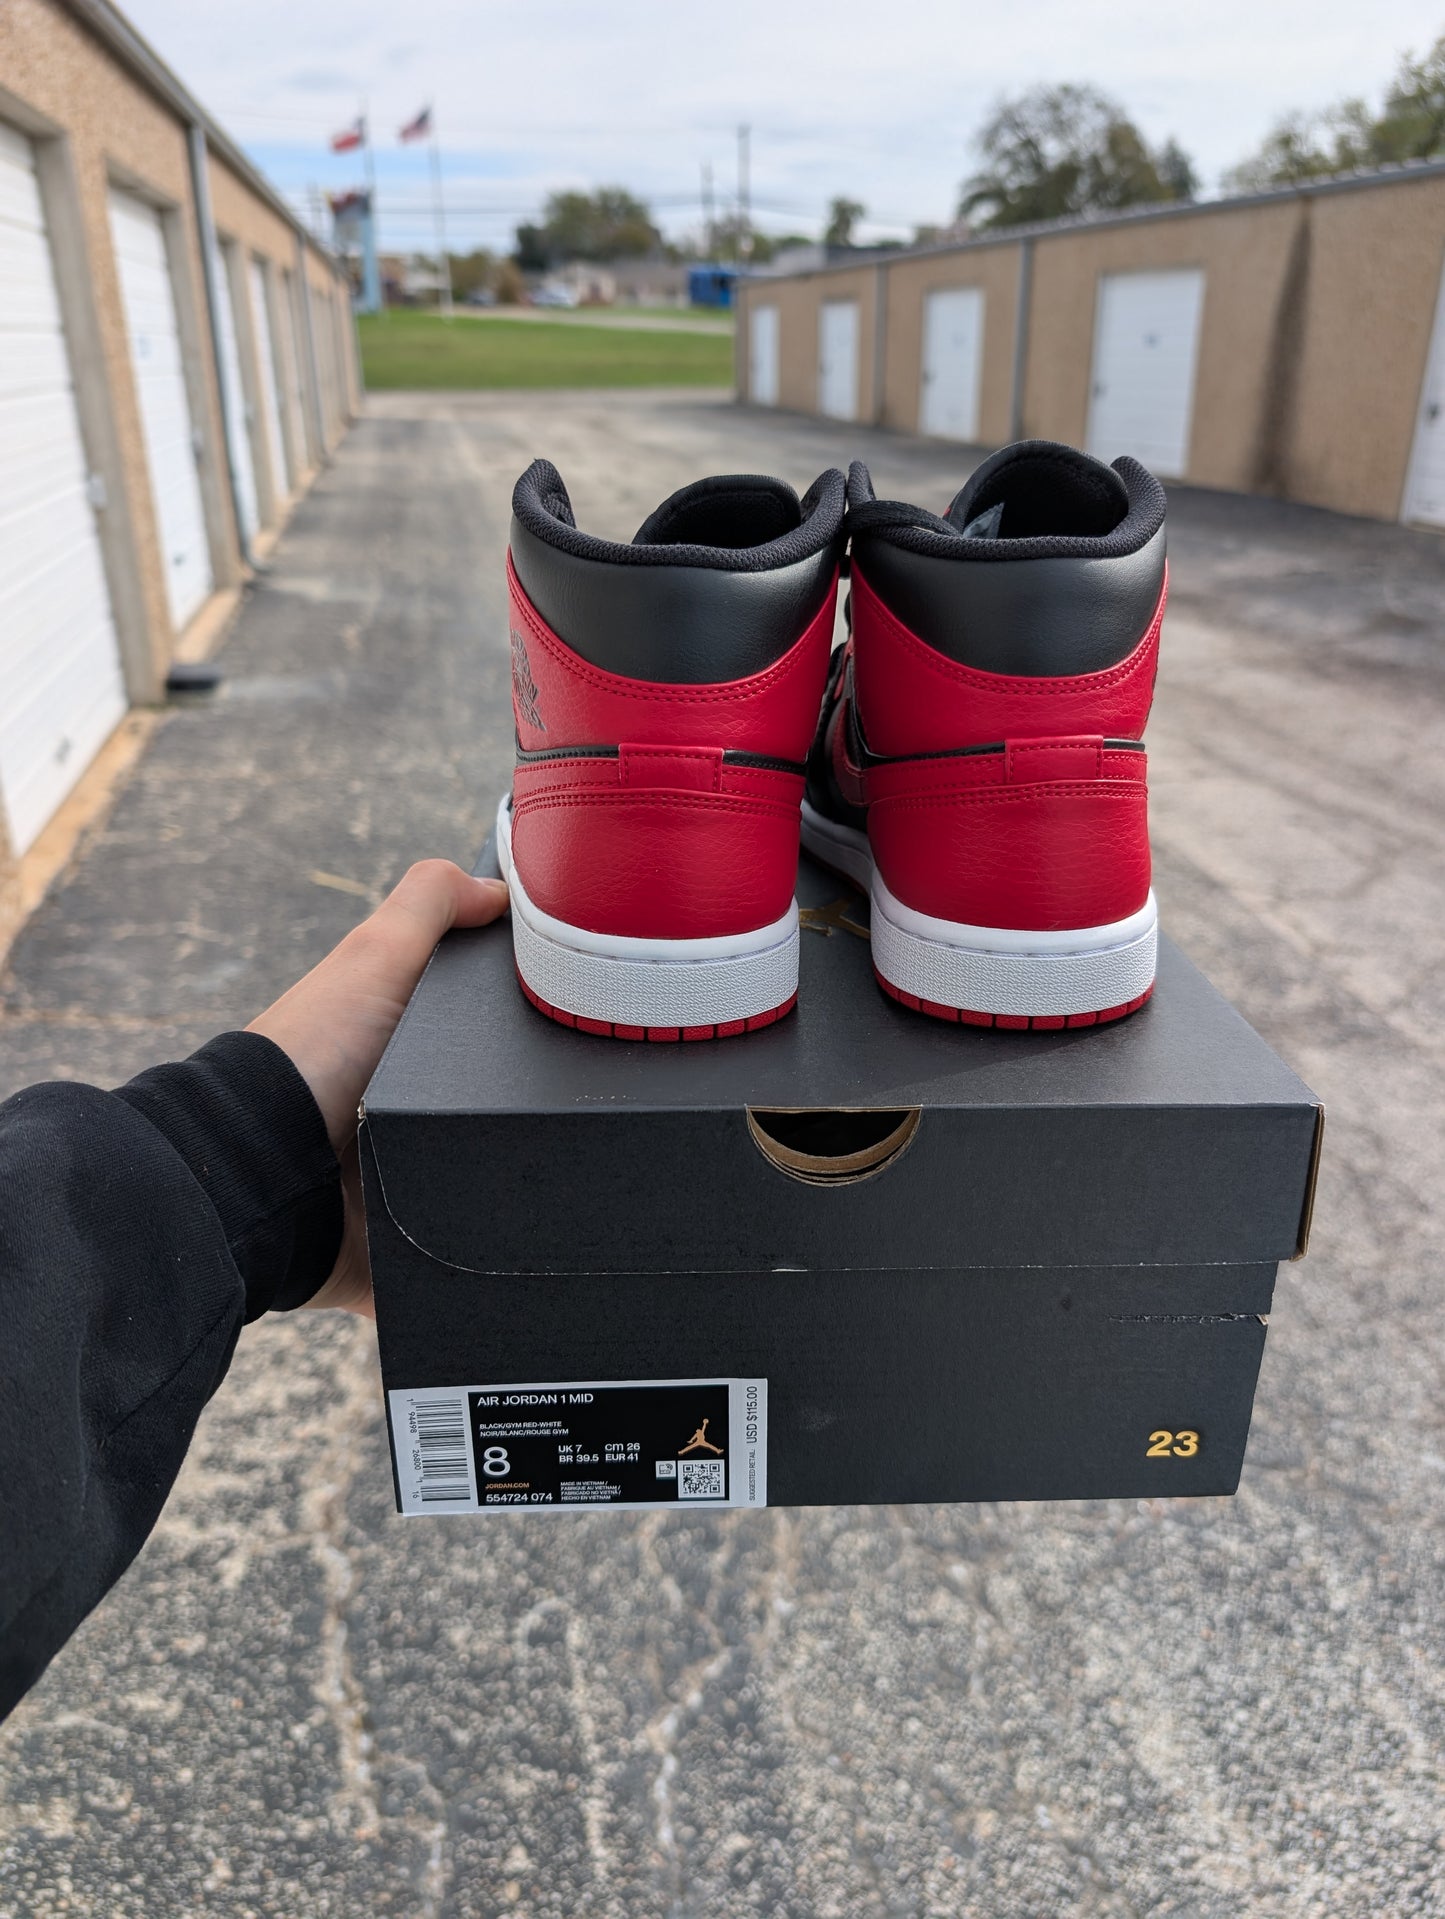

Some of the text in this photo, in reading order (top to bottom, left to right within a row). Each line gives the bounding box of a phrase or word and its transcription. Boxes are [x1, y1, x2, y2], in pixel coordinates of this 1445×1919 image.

[478, 1394, 594, 1406] AIR JORDAN 1 MID
[746, 1386, 758, 1420] $115.00
[408, 1412, 417, 1434] 94498
[480, 1429, 551, 1437] NOIR/BLANC/ROUGE
[746, 1423, 758, 1444] USD
[558, 1444, 582, 1453] UK 7
[604, 1442, 640, 1451] cm 26
[1146, 1430, 1199, 1456] 23
[483, 1446, 511, 1476] 8
[576, 1454, 600, 1462] 39.5
[486, 1492, 553, 1502] 554724 074
